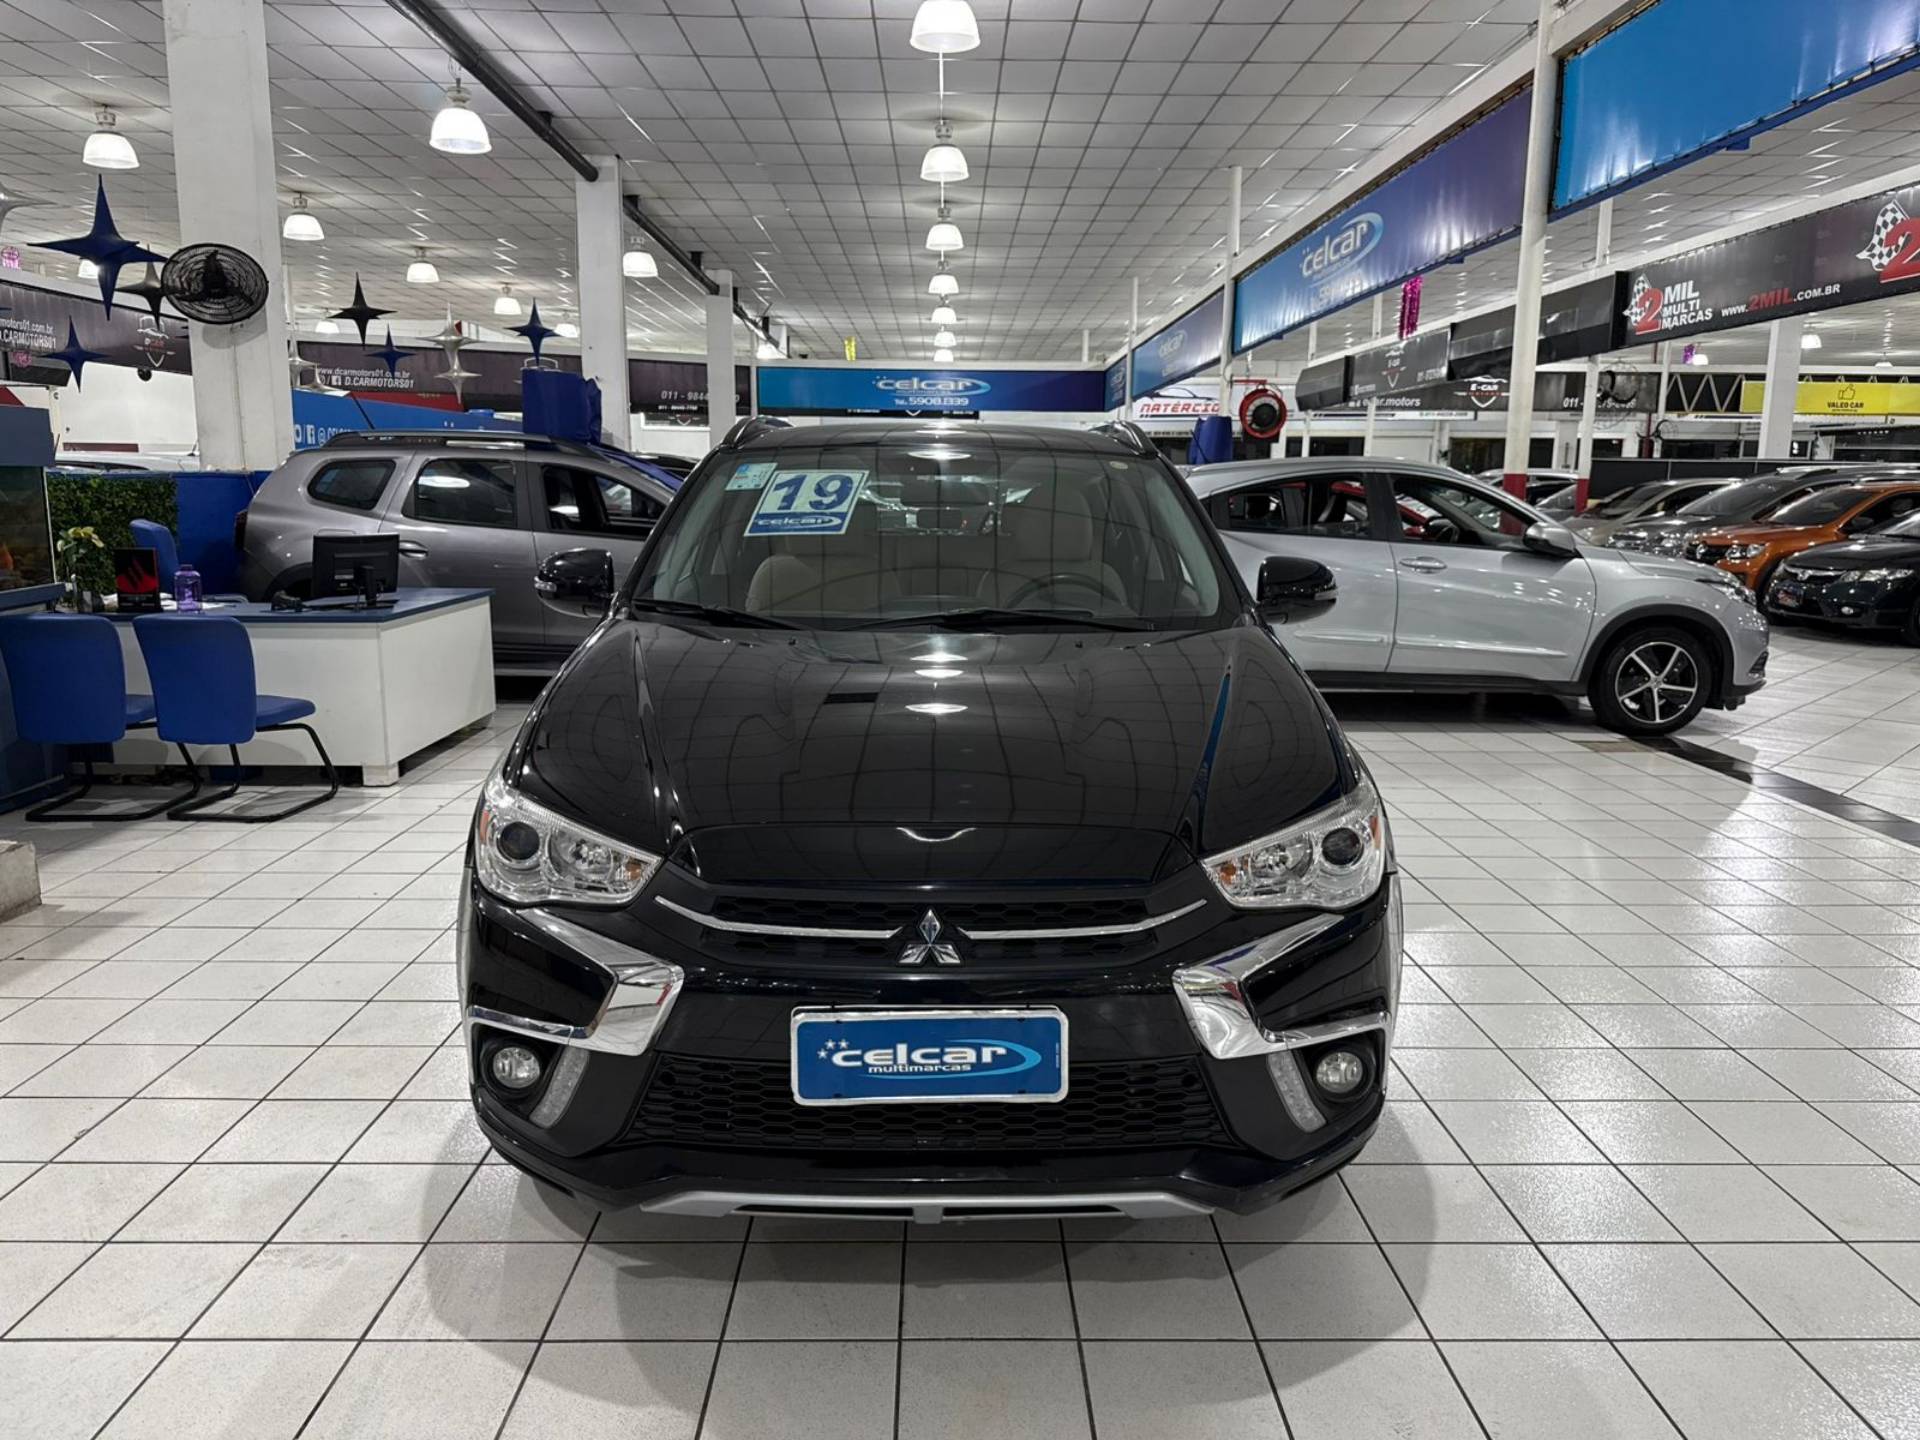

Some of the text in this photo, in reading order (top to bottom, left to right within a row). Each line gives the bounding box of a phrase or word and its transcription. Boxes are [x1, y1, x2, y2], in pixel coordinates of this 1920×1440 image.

[1302, 221, 1368, 278] celcar
[1635, 279, 1700, 335] 2 MIL
[1663, 299, 1701, 318] MULTI
[1661, 307, 1714, 330] MARCAS
[876, 377, 972, 390] celcar
[1563, 397, 1579, 408] 011
[1850, 401, 1865, 409] CAR
[773, 474, 854, 510] 19
[757, 516, 835, 526] celcar
[831, 1043, 1008, 1067] celcar
[868, 1063, 972, 1074] multimarcas
